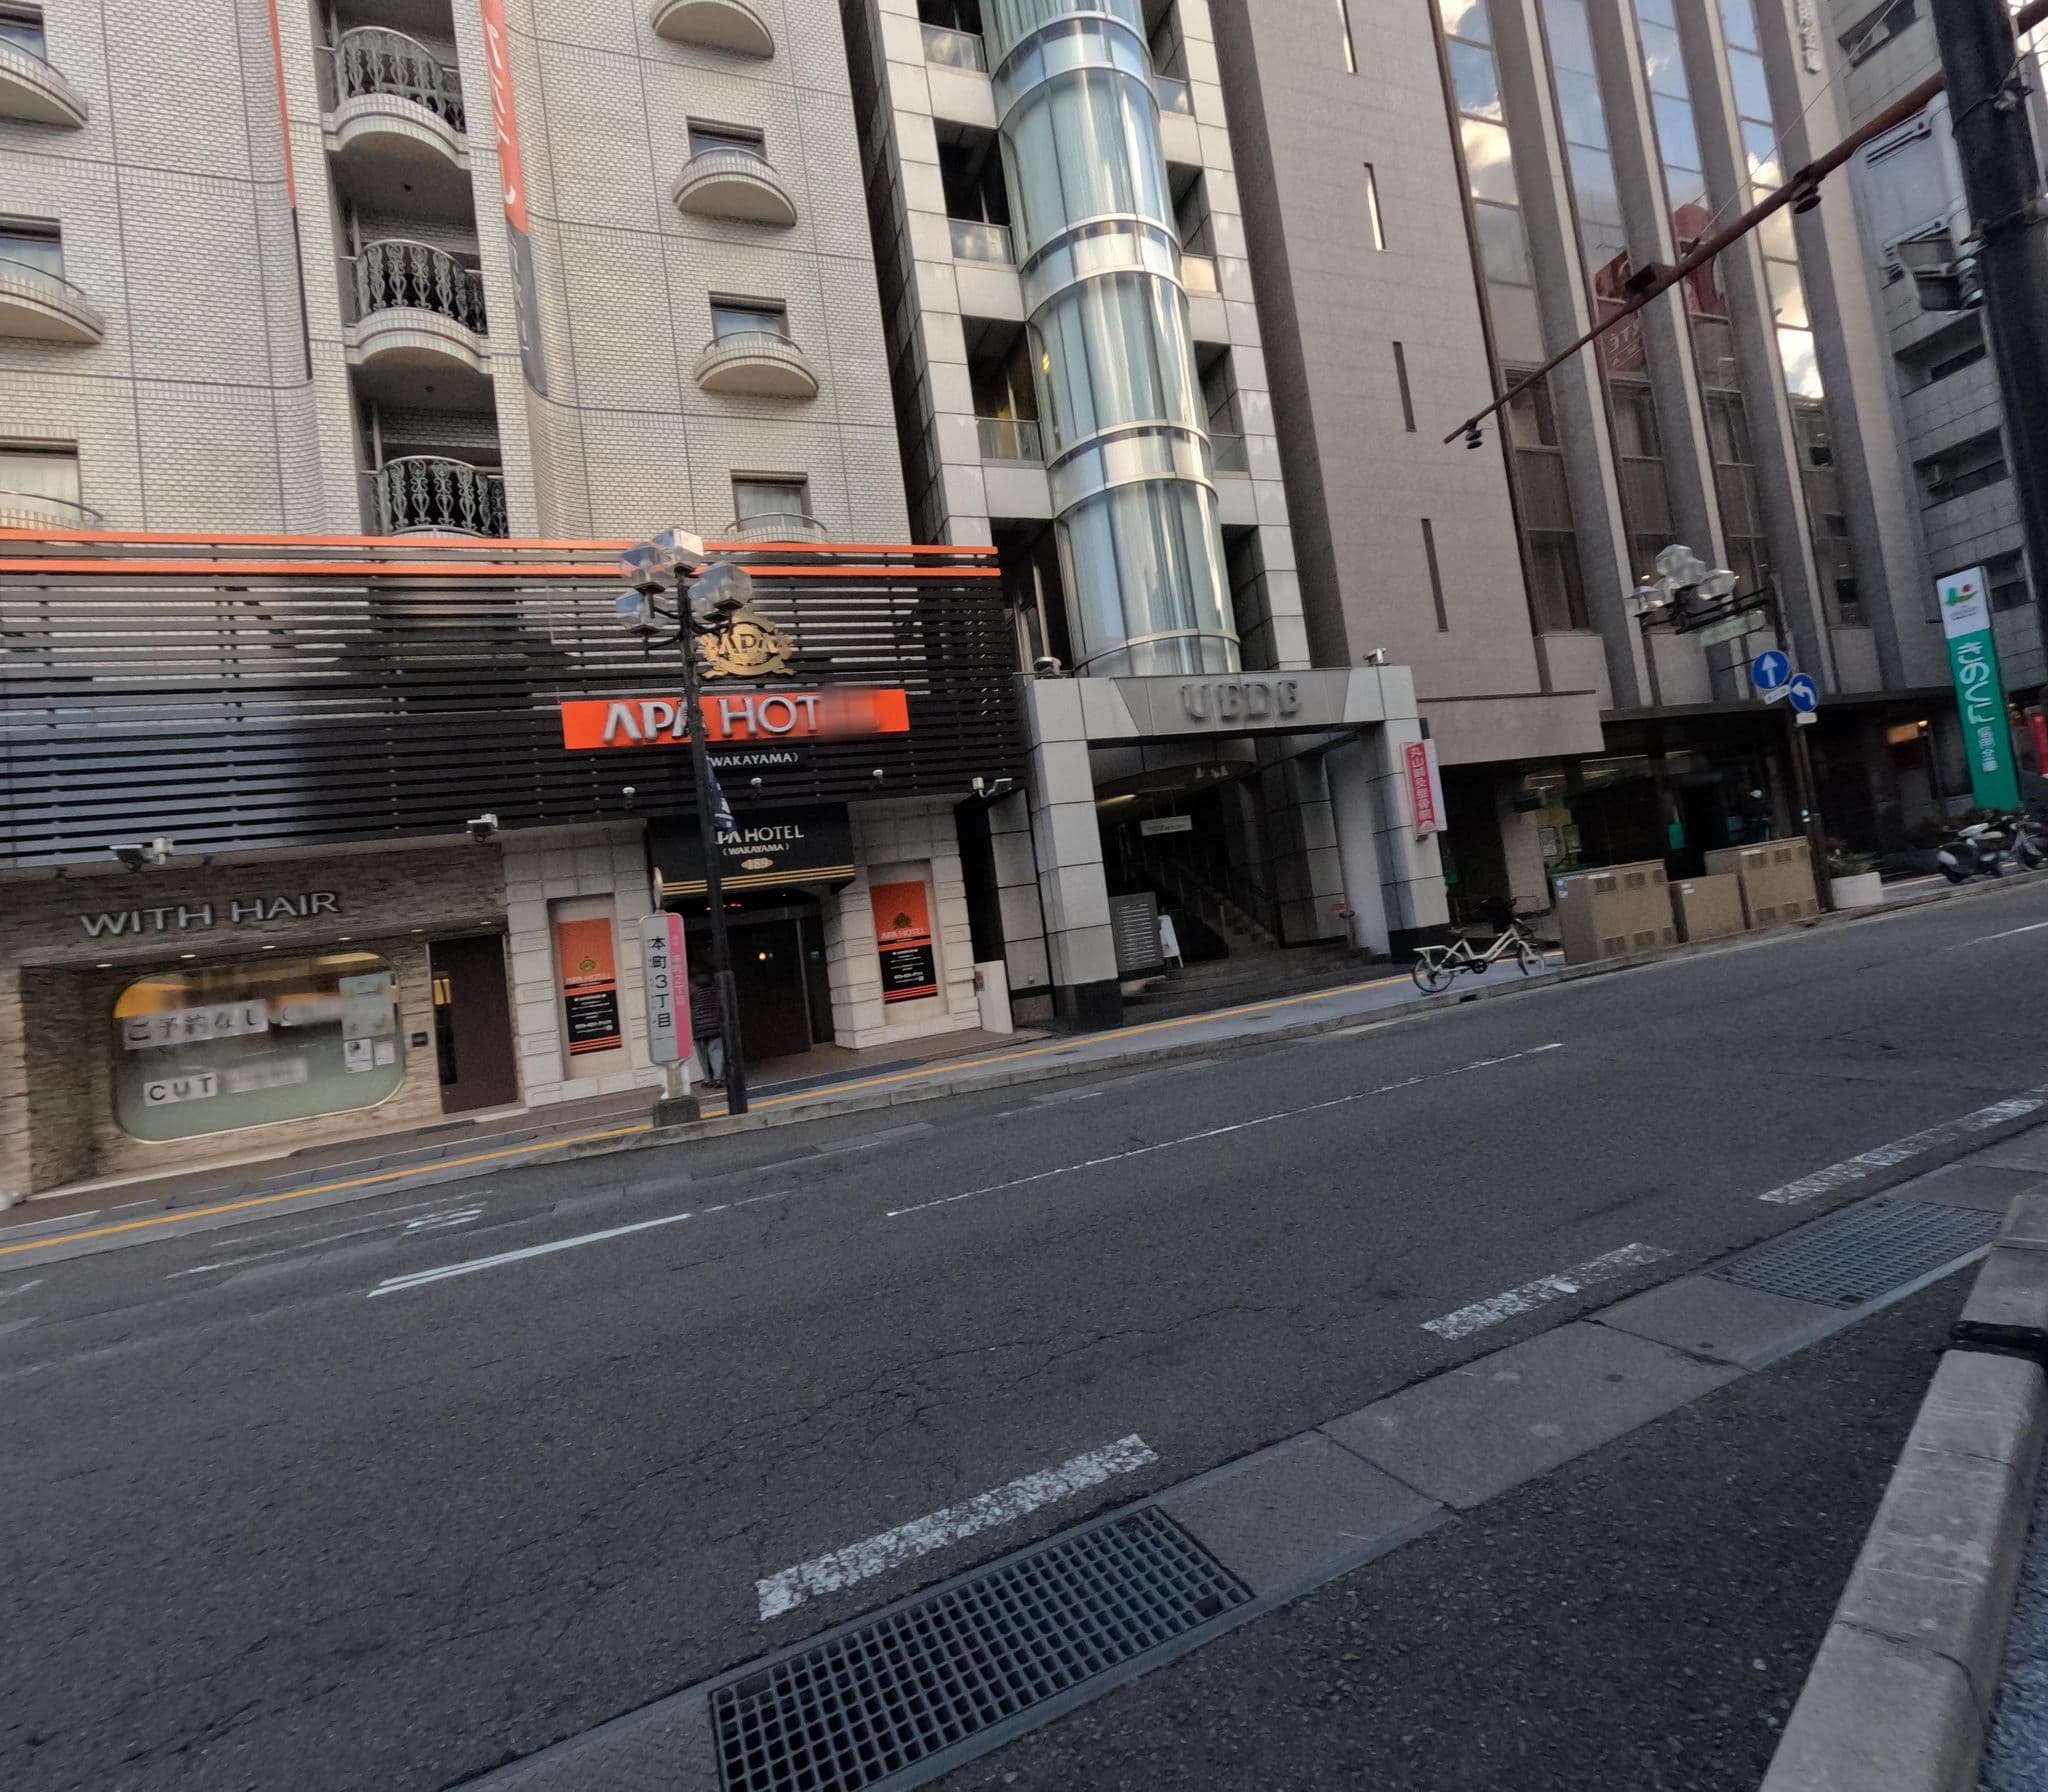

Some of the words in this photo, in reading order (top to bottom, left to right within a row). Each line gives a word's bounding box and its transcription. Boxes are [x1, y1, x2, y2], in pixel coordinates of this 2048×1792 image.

[744, 825, 805, 842] HOTEL
[80, 904, 214, 937] WITH
[231, 892, 341, 923] HAIR
[650, 936, 671, 1028] 本町3丁目
[149, 1076, 213, 1102] CUT
